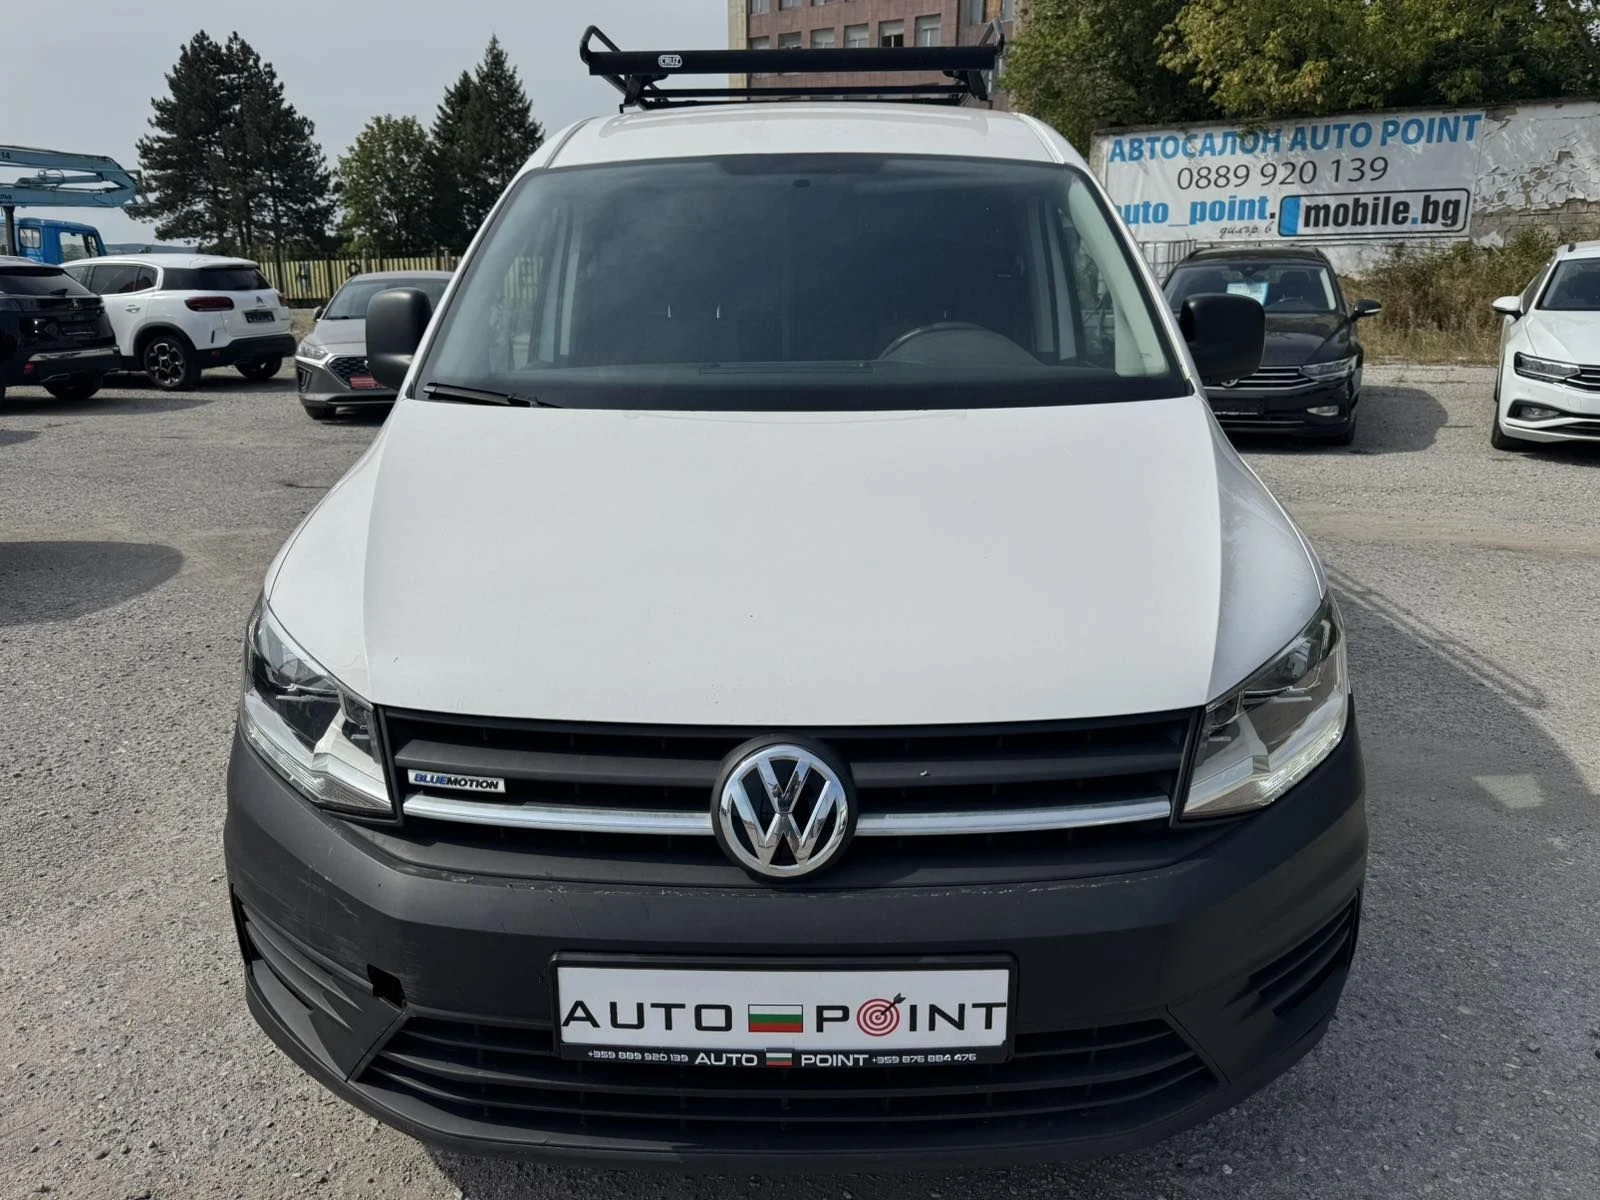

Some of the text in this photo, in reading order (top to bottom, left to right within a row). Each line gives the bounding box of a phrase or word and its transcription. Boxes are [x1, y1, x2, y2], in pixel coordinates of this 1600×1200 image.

[660, 56, 681, 66] CRUZ
[1109, 114, 1482, 162] АВТОСАЛОН AUTO POINT
[1177, 156, 1389, 190] 0889 920 139
[1303, 194, 1461, 228] mobile.bg
[414, 773, 499, 790] BLUEMOTION
[561, 1000, 733, 1032] AUTO
[694, 1053, 758, 1066] AUTO
[801, 1054, 869, 1067] POINT
